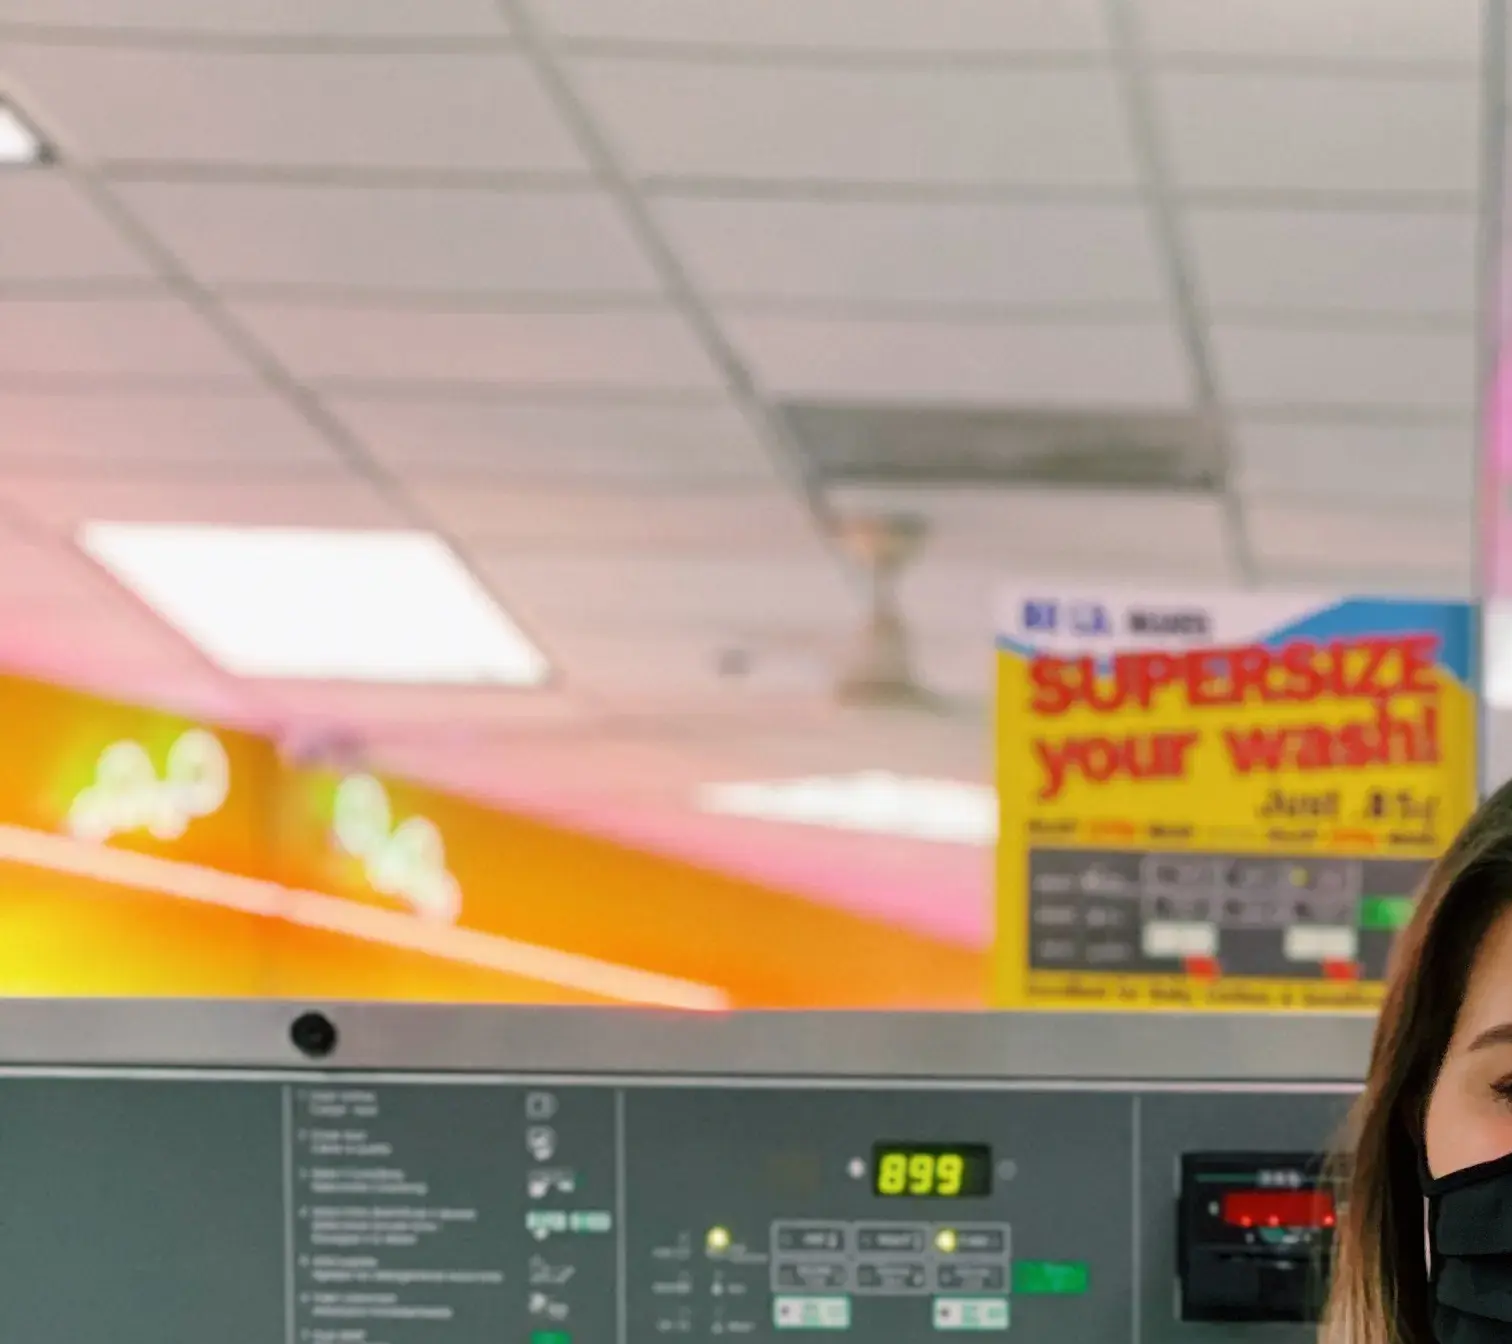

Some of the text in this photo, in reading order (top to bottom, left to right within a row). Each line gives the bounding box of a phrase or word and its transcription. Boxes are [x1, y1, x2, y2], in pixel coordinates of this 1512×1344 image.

[1028, 634, 1441, 717] SUPERSIZE
[1033, 698, 1441, 801] your wash!
[877, 1153, 964, 1194] 899
